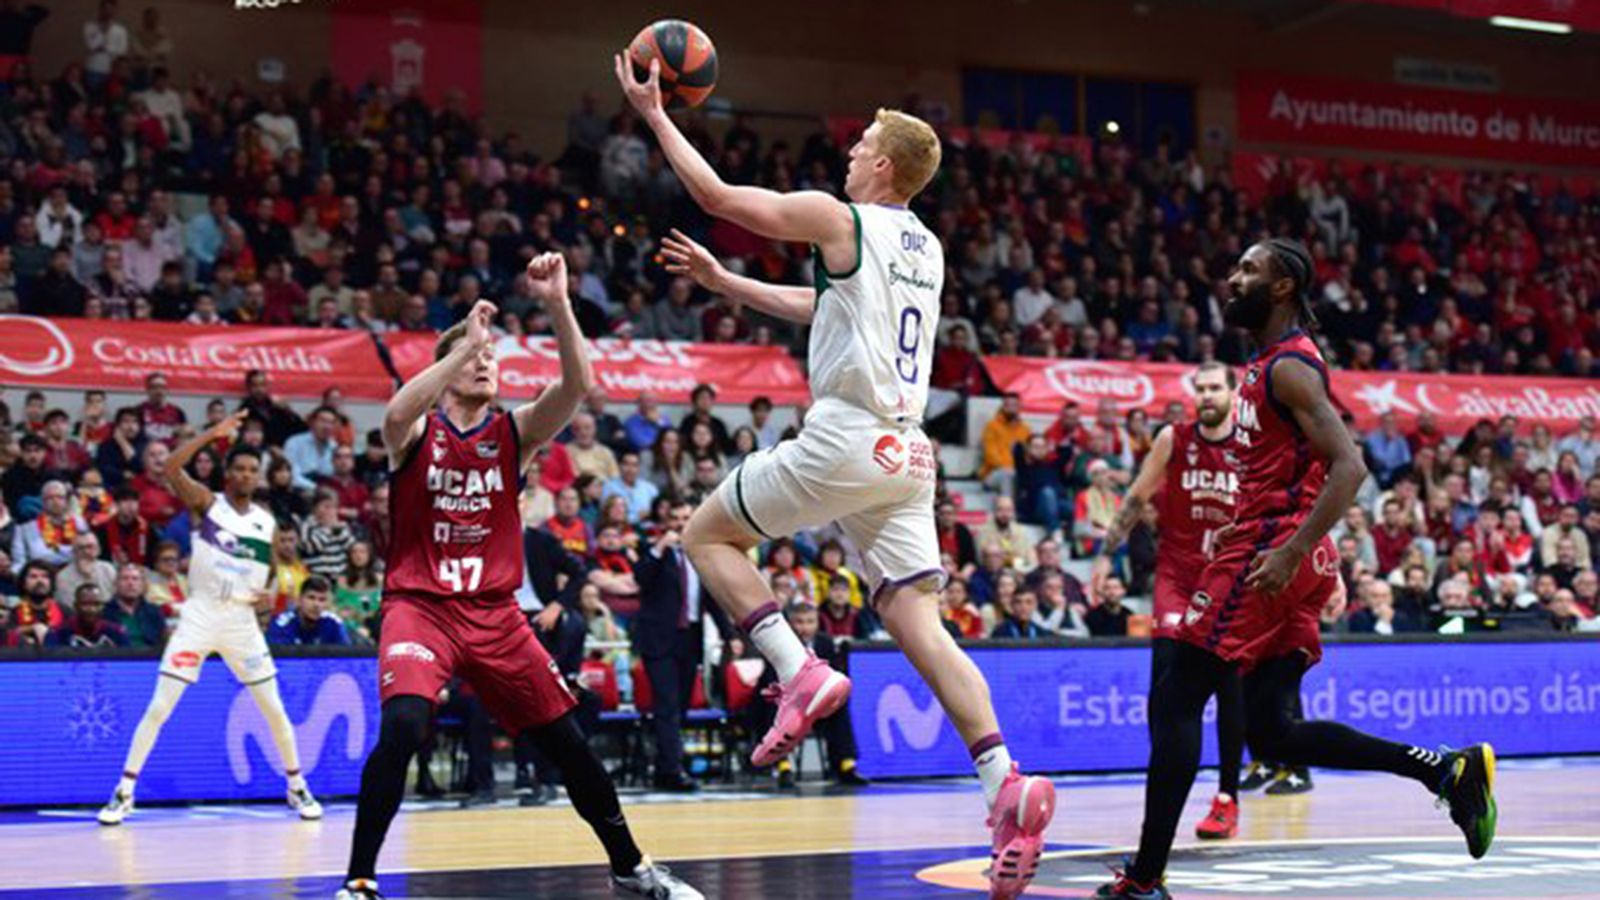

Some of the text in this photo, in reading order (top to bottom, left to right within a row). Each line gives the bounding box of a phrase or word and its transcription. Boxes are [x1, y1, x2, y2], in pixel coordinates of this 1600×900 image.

[1269, 89, 1477, 138] Ayuntamiento
[1486, 109, 1520, 140] de
[92, 337, 203, 366] Costa
[896, 306, 922, 384] 9
[427, 464, 504, 496] UCAM
[439, 556, 484, 592] 47
[1059, 685, 1148, 726] Esta
[1348, 674, 1532, 730] seguimos
